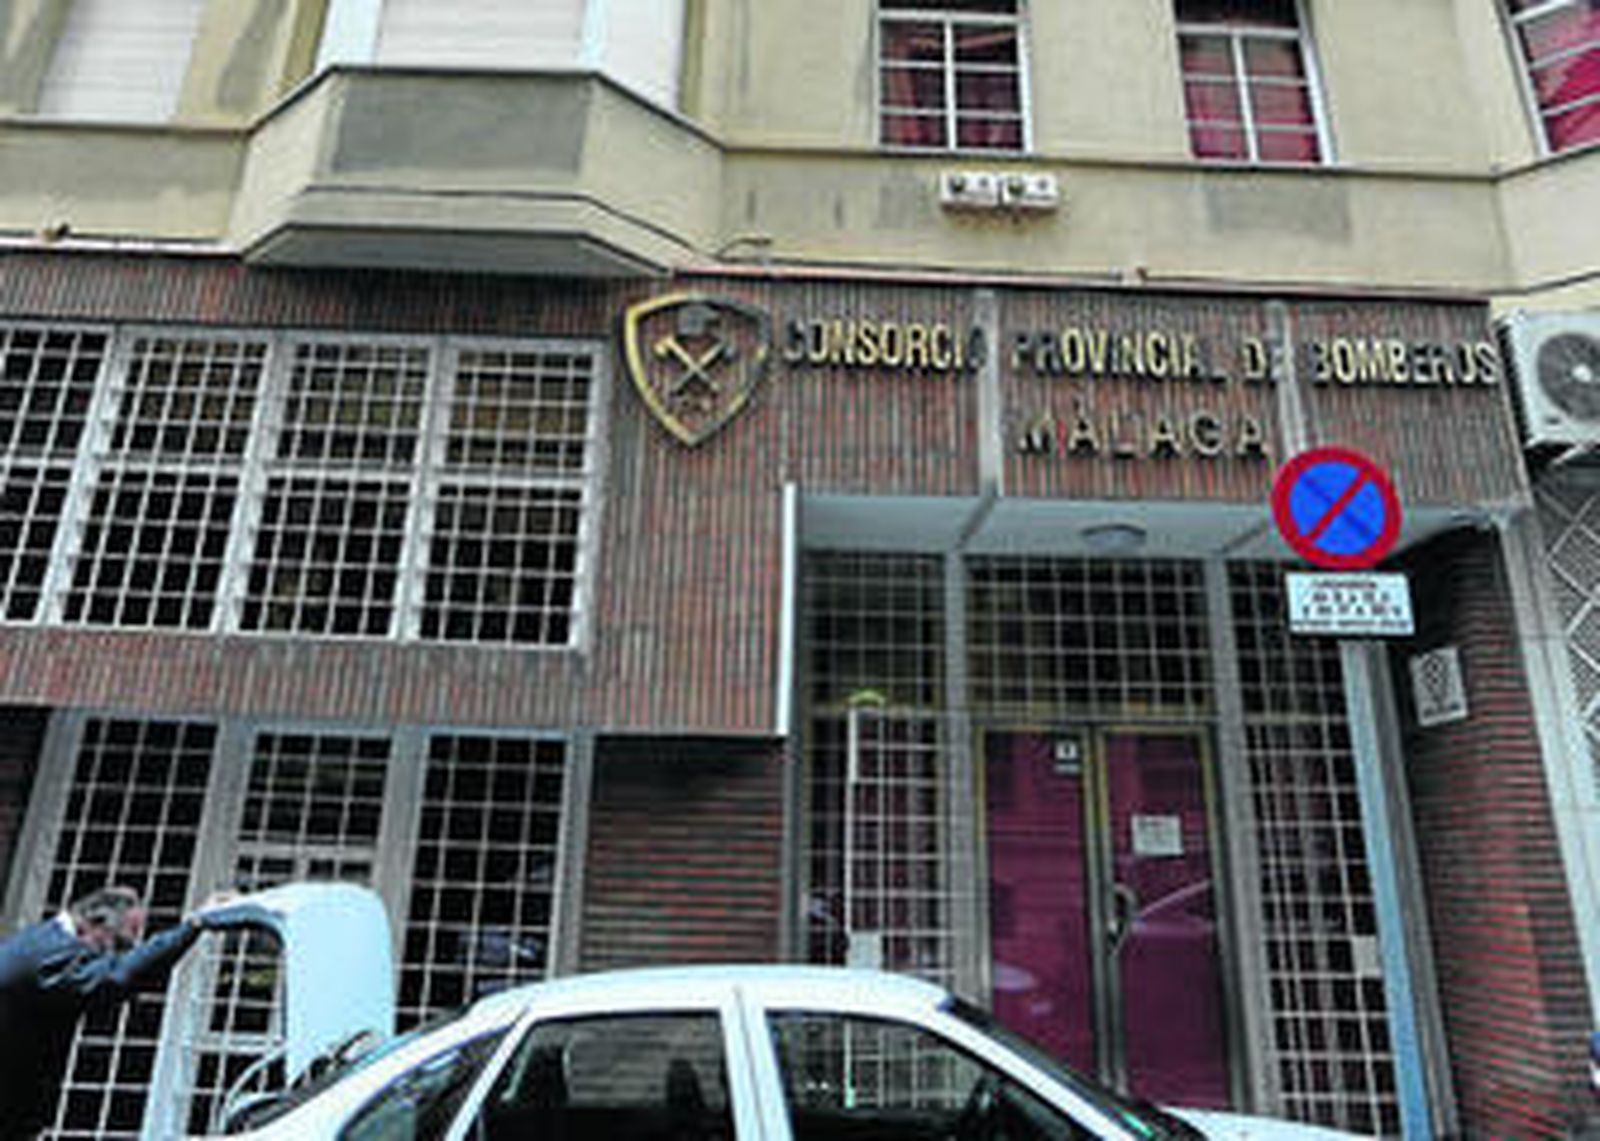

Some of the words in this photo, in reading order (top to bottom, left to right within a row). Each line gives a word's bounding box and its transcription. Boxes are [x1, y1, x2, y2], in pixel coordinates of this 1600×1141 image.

[784, 317, 988, 370] CONSORCIO
[1010, 325, 1227, 378] PROVINCIAL
[1311, 337, 1499, 384] BOMBEROS
